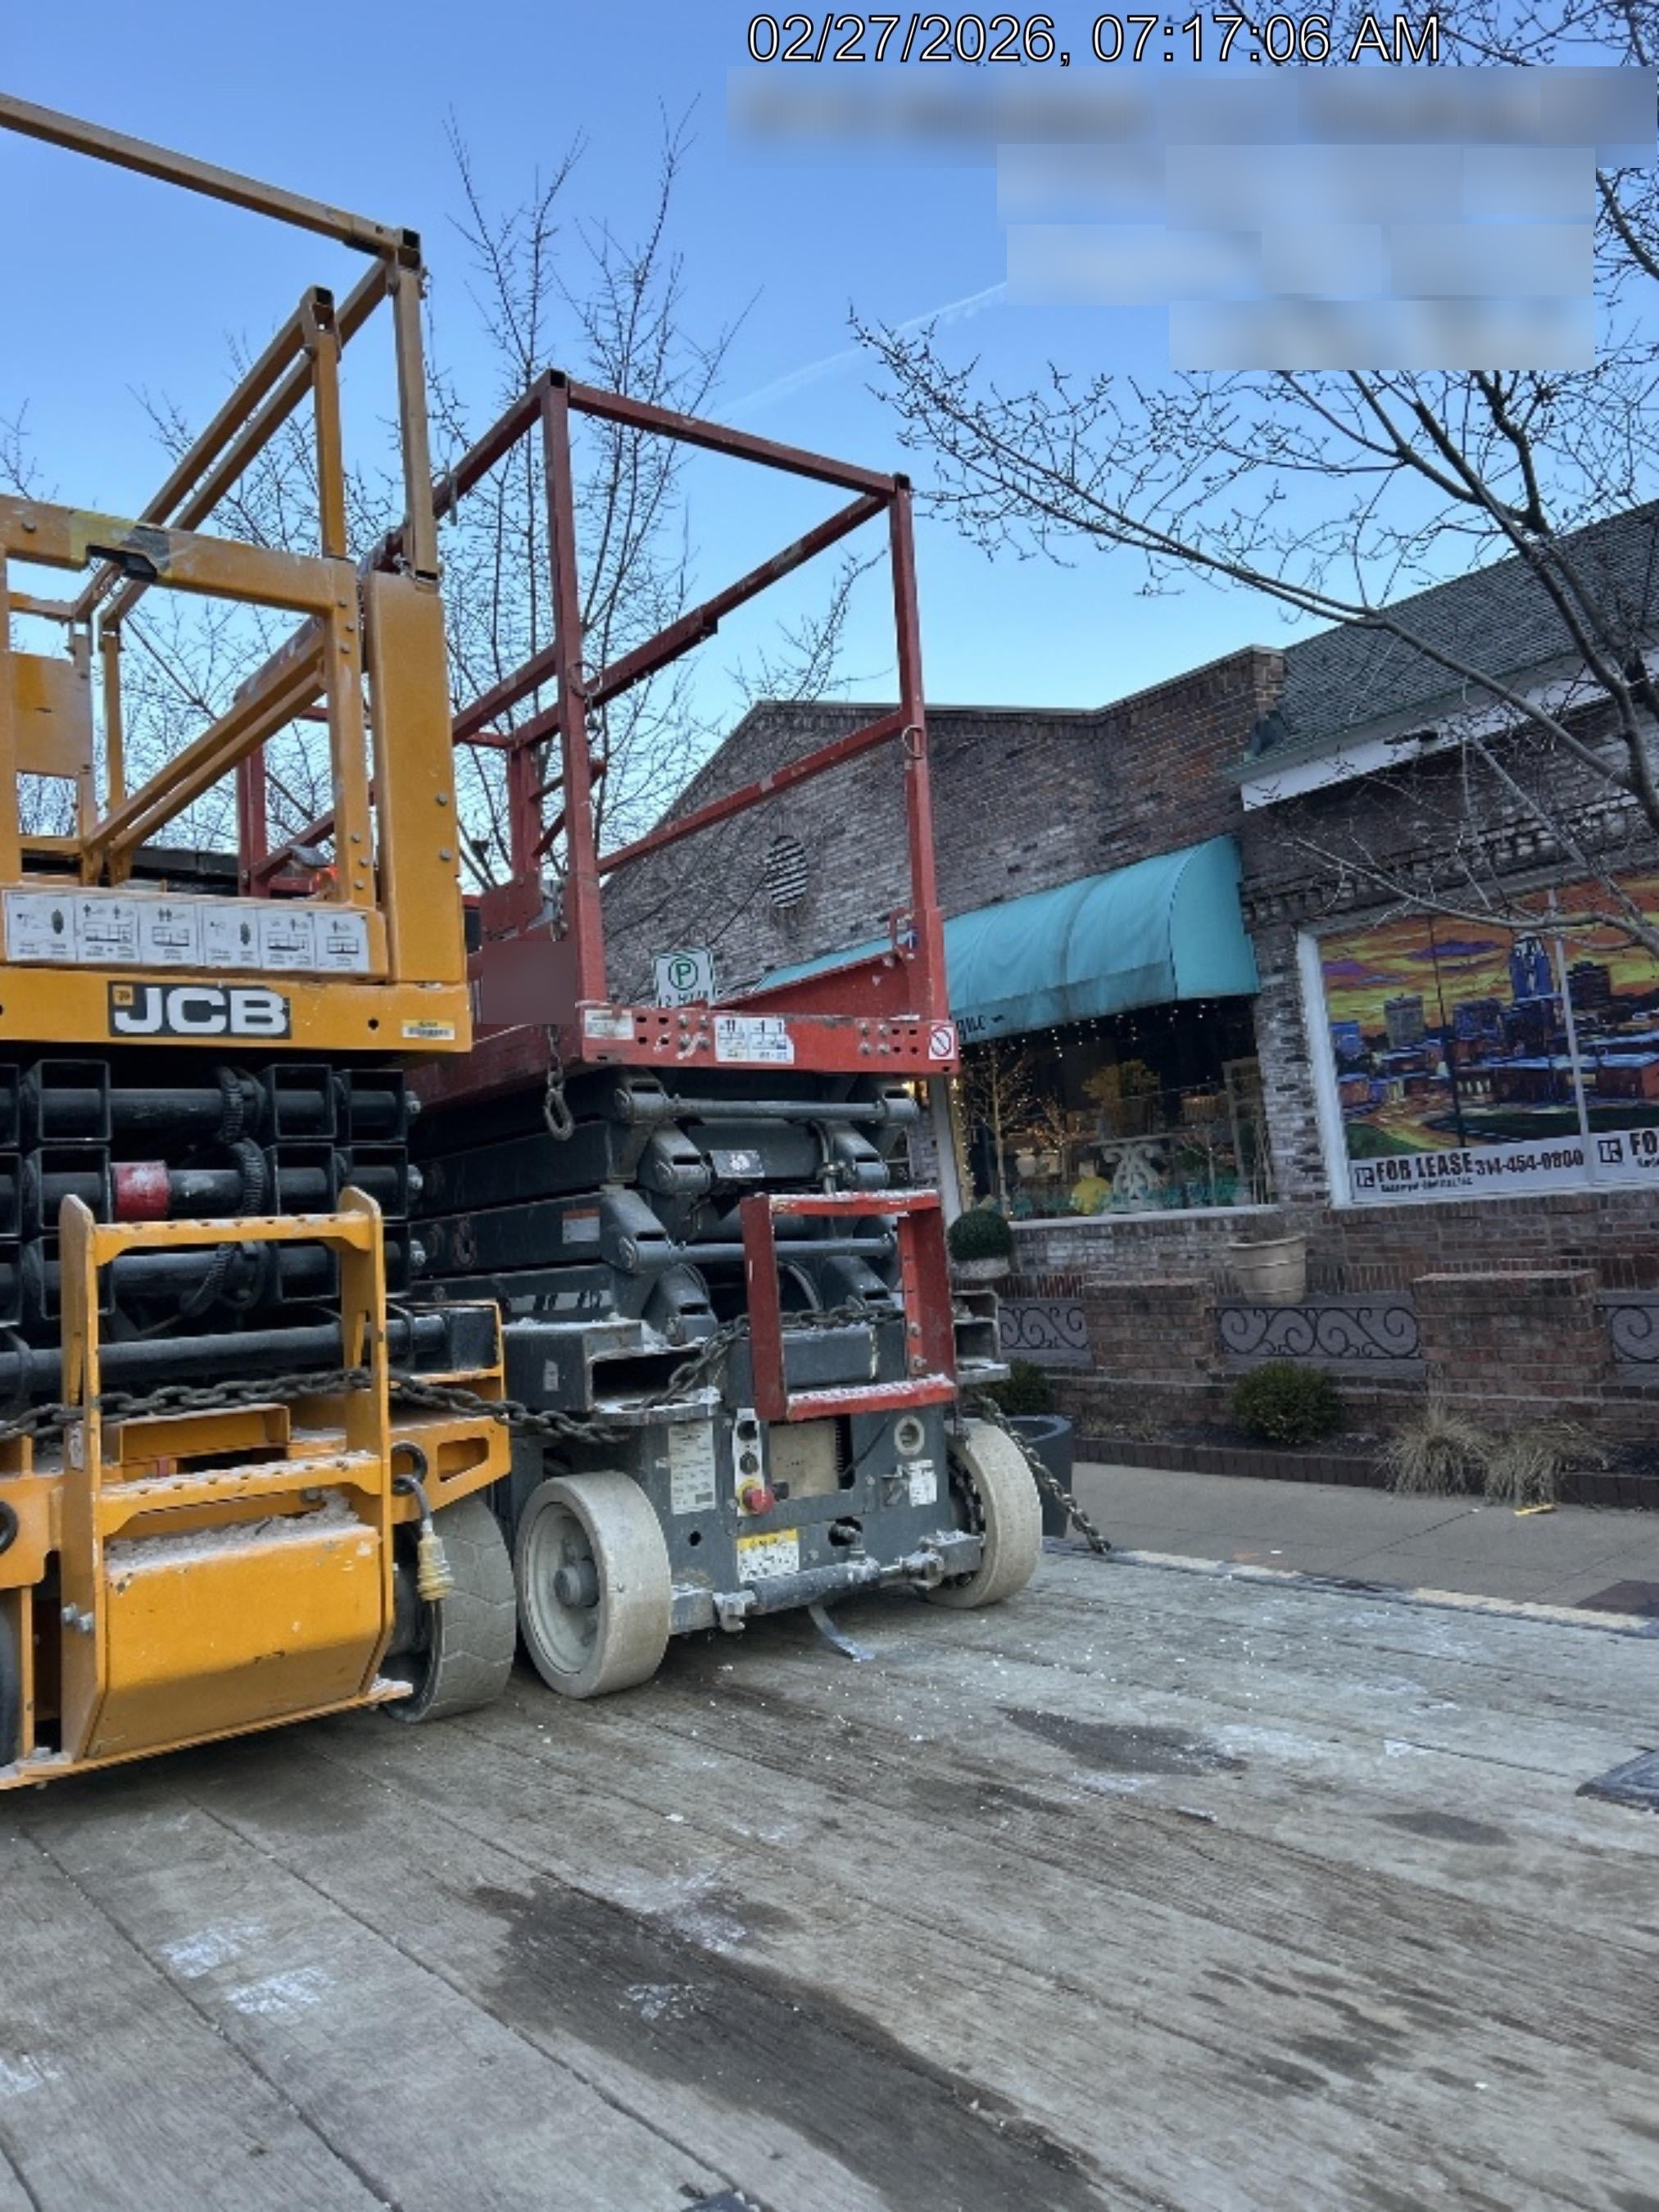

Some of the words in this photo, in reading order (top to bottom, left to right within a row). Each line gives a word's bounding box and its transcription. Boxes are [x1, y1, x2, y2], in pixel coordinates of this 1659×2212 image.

[675, 963, 691, 986] P
[113, 986, 288, 1034] JCB
[1376, 1159, 1412, 1182] FOR
[1416, 1152, 1473, 1178] LEASE
[1475, 1149, 1584, 1176] 314-454-0800
